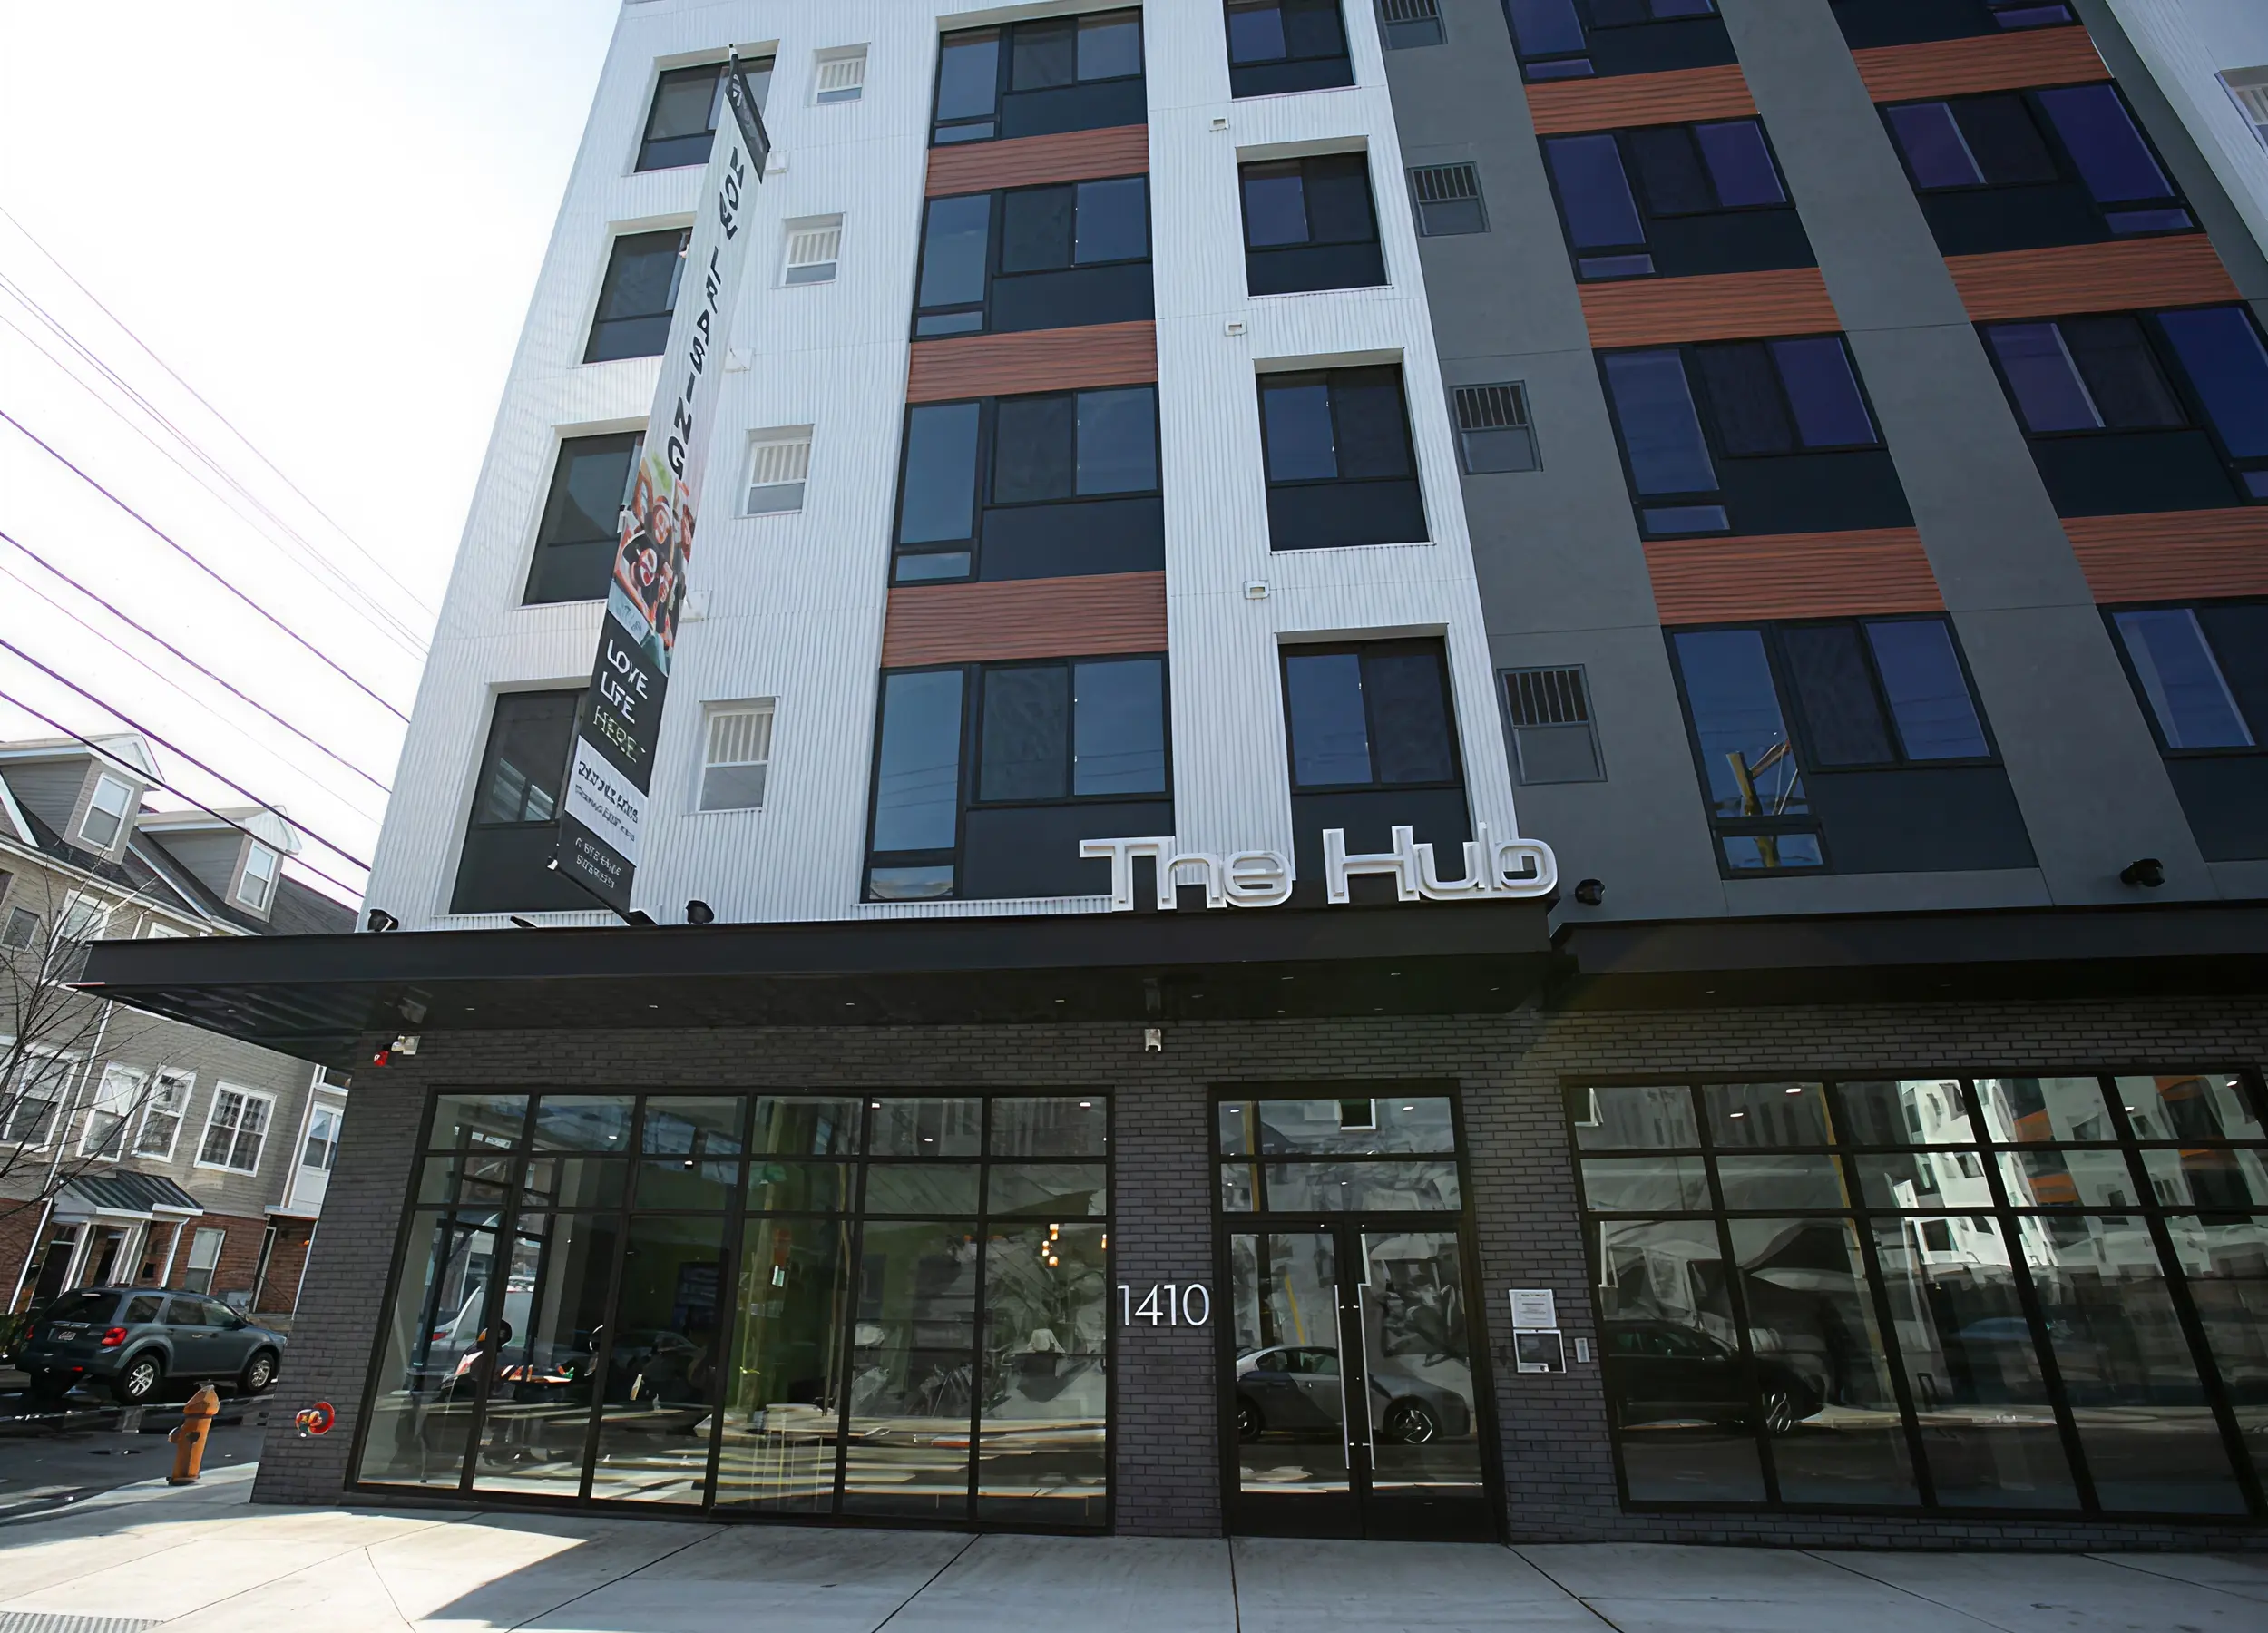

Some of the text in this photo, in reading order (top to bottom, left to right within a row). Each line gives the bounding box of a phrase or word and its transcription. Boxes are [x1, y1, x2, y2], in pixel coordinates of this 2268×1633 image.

[607, 638, 650, 699] LOVE
[600, 671, 636, 724] LIFE
[1079, 821, 1559, 912] The Hub
[1117, 1283, 1210, 1326] 1410
